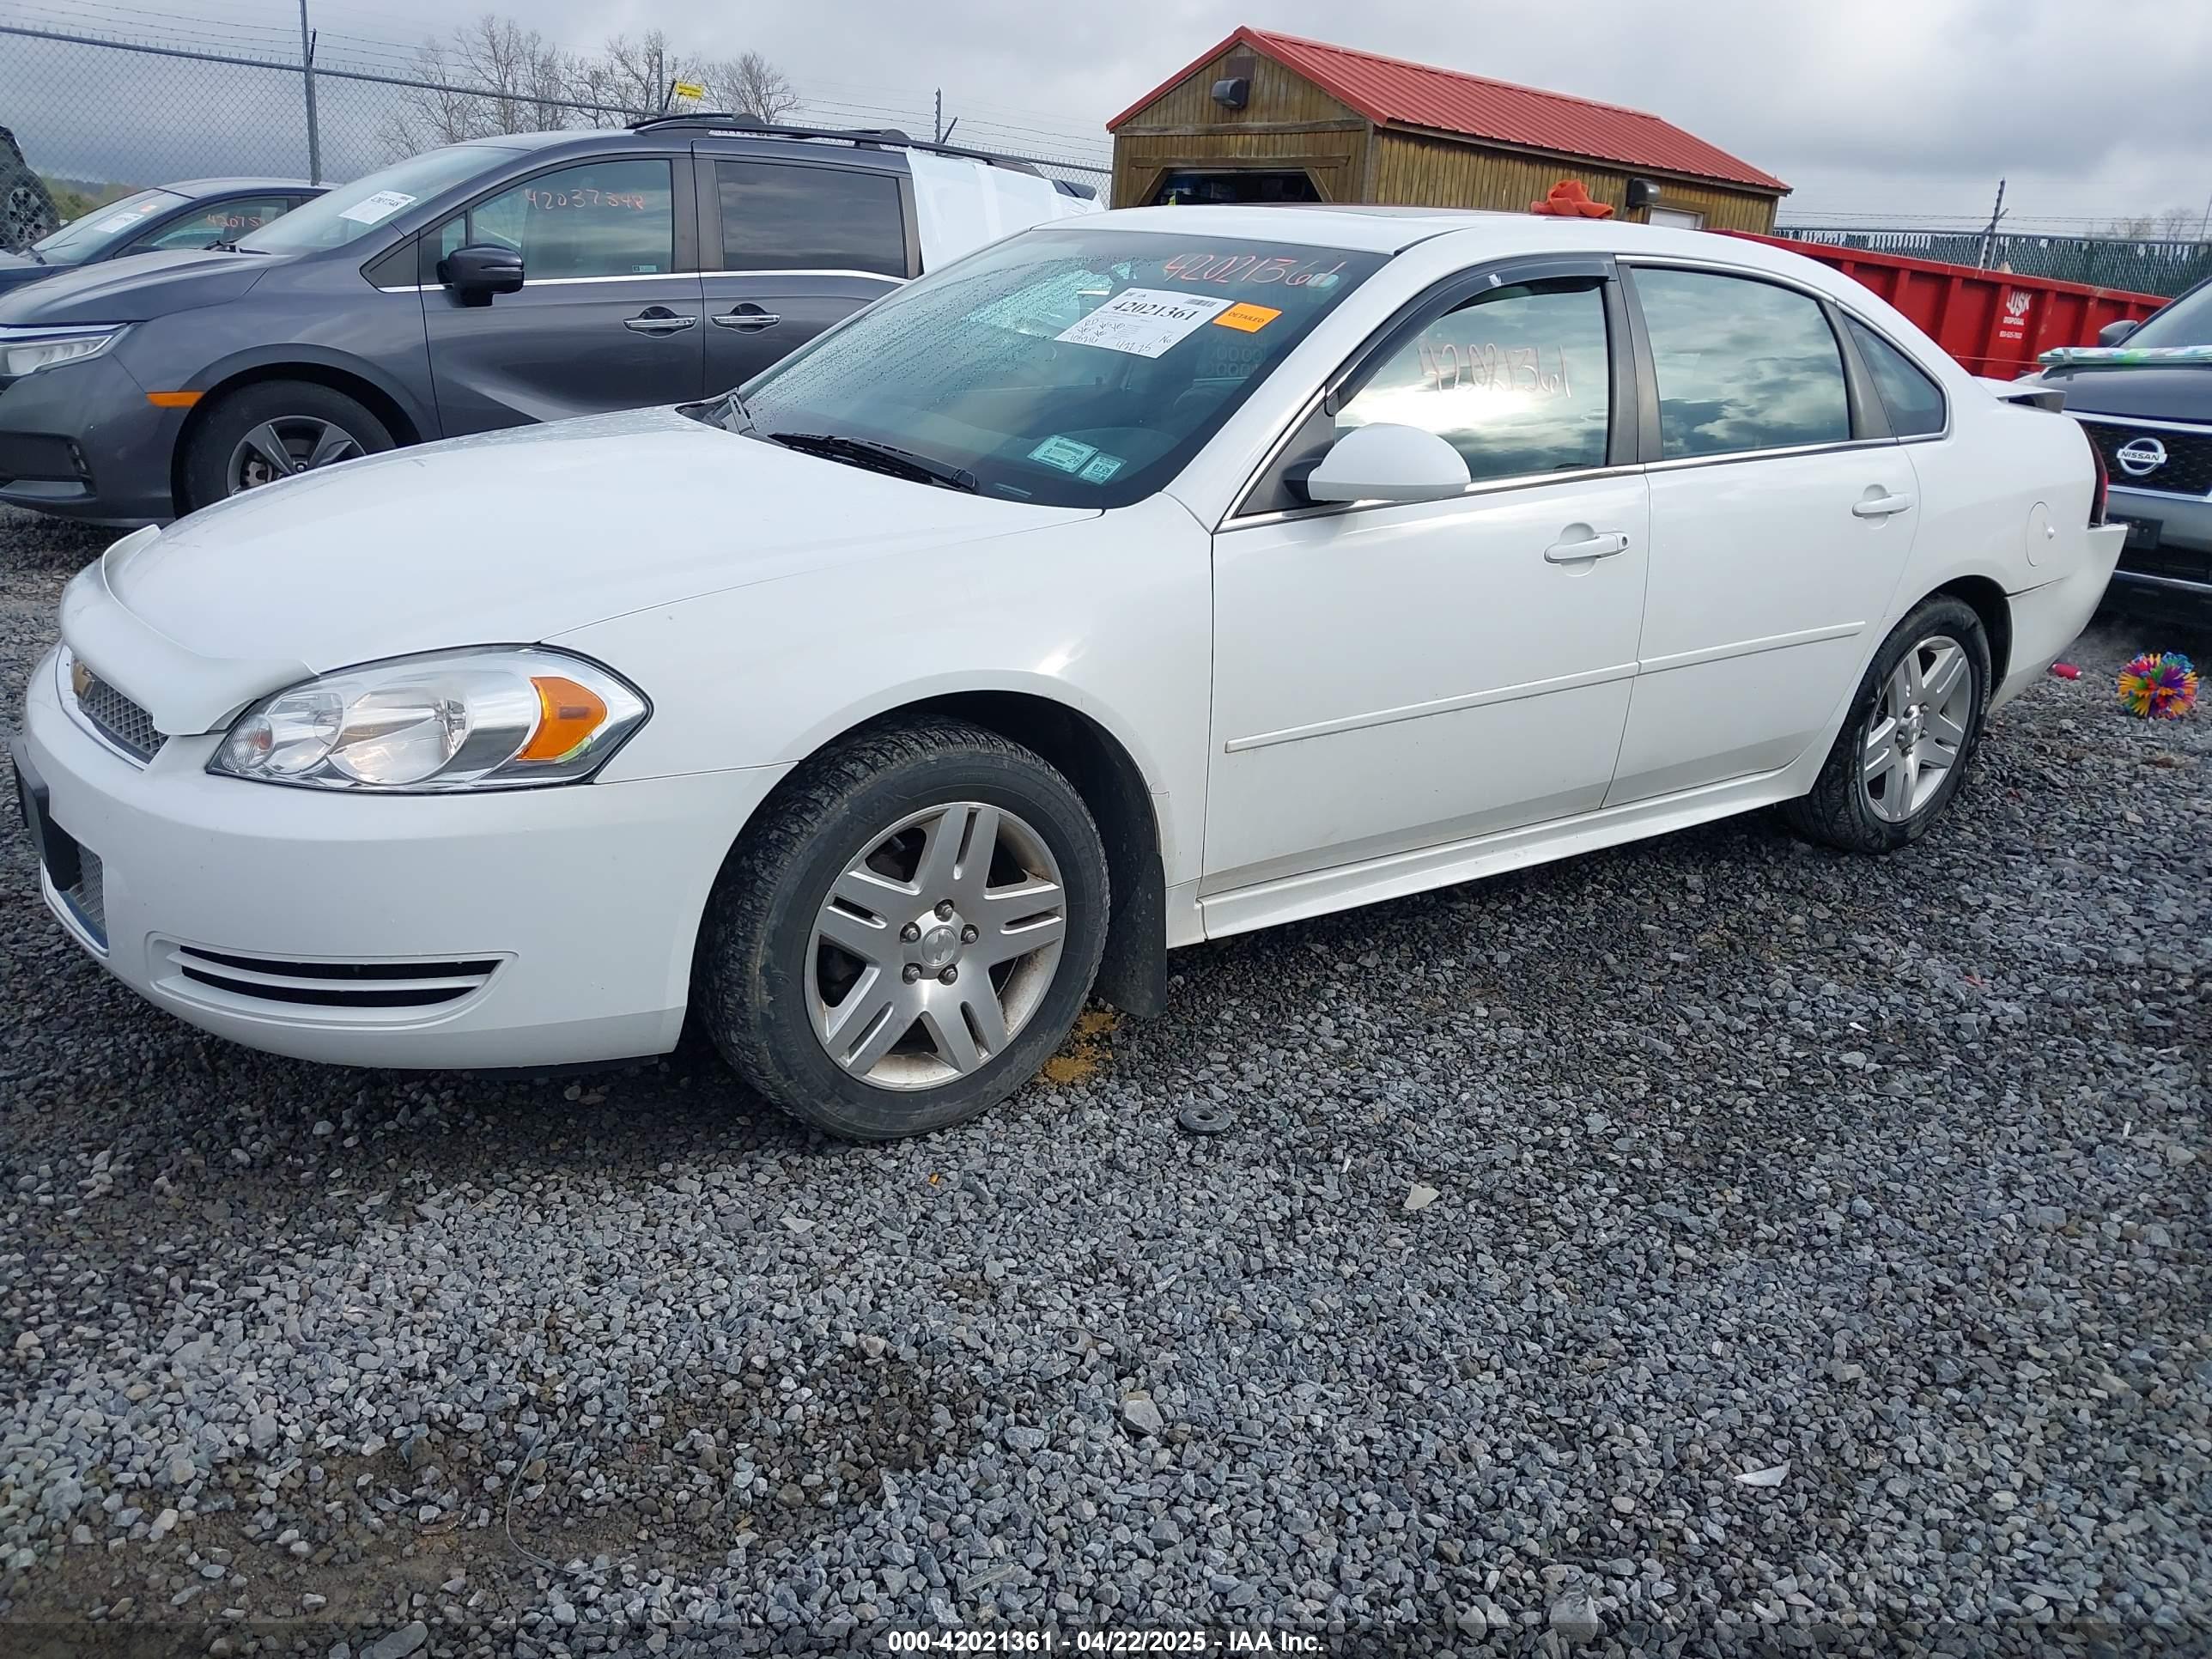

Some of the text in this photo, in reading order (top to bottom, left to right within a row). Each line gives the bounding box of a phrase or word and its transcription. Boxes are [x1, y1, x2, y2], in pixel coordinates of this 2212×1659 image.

[1164, 253, 1347, 287] 42021361
[1112, 301, 1200, 321] 42021361
[1228, 312, 1265, 324] DETAILED
[1067, 455, 1082, 465] 26
[2120, 450, 2160, 462] NISSAN
